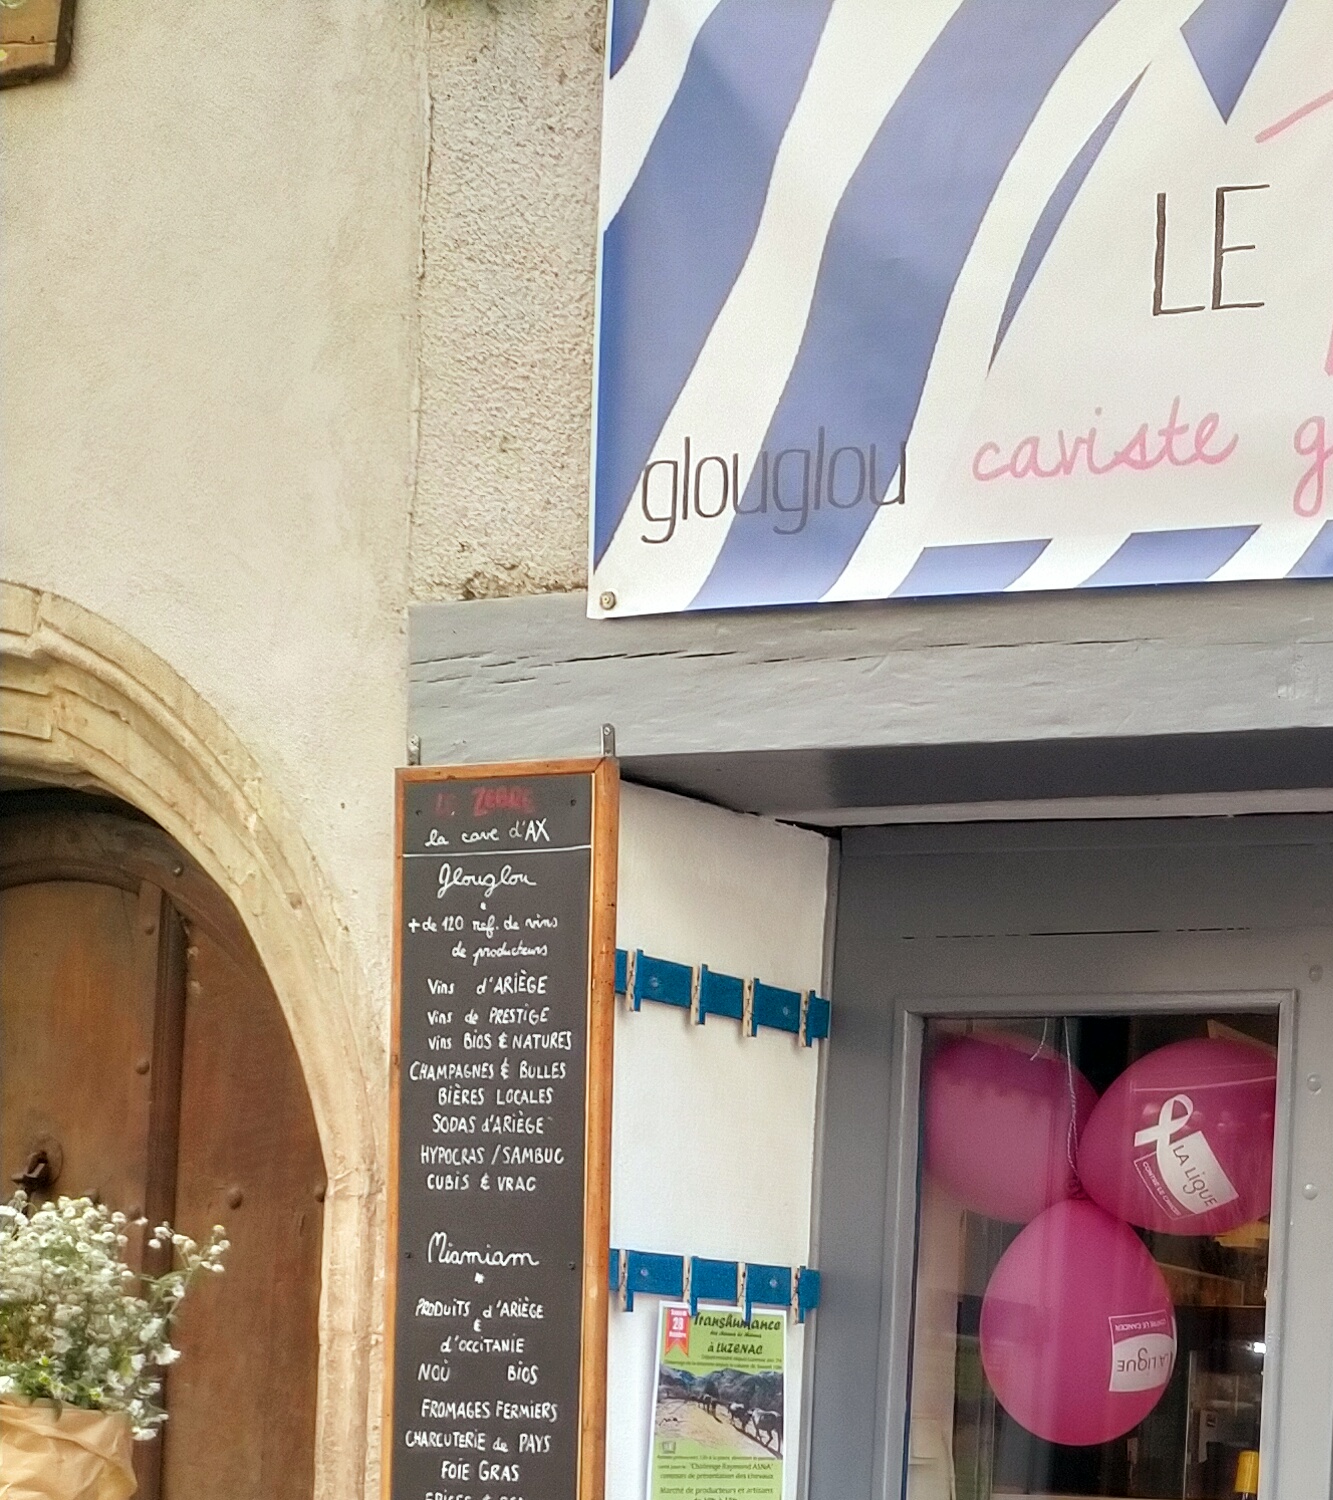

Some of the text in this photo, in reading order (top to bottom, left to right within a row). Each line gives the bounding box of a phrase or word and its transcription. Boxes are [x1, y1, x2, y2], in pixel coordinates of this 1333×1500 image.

[1152, 179, 1270, 318] LE
[971, 397, 1237, 486] caviste
[638, 430, 910, 546] glouglou
[426, 827, 449, 846] la
[461, 827, 499, 843] cave
[442, 915, 463, 932] 120
[525, 916, 558, 929] vins
[473, 942, 547, 968] producteurs
[511, 1031, 572, 1051] NATURES
[410, 1059, 566, 1081] CHAMPAGNES BULLES
[496, 1086, 553, 1106] LOCALES
[432, 1114, 475, 1134] SODAS
[421, 1144, 484, 1165] HYPOCRAS
[427, 1171, 536, 1192] CUBIS VRAC
[507, 1360, 538, 1384] BIOS
[421, 1399, 557, 1422] FROMAGES FERMIERS
[405, 1429, 486, 1450] CHARCUTERIE
[519, 1432, 550, 1453] PAYS
[441, 1457, 519, 1482] FOIE GRAS
